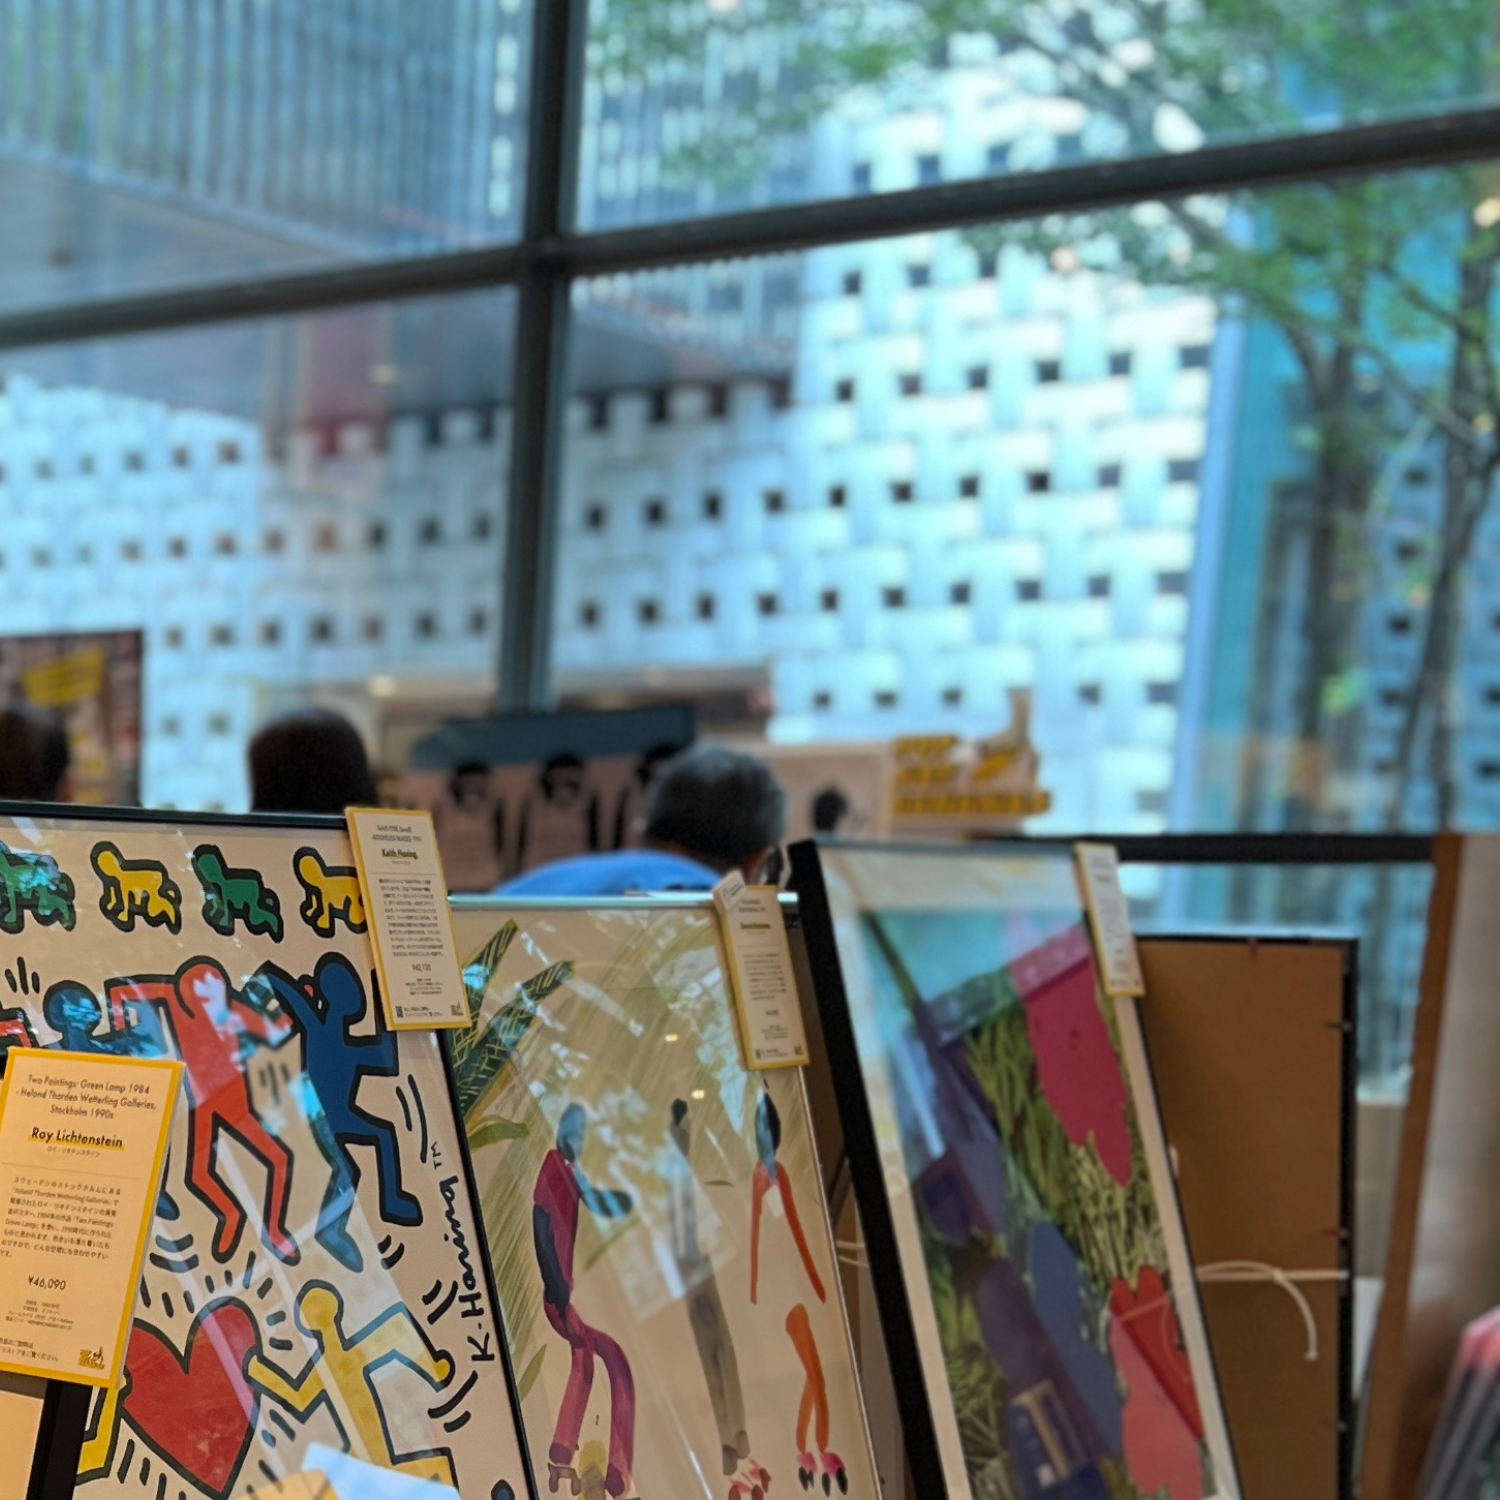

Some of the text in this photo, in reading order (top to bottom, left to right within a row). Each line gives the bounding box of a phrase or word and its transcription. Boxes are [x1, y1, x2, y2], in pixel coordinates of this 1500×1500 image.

[28, 1074, 43, 1085] Two
[80, 1079, 104, 1091] Green
[105, 1082, 126, 1094] Lamp
[128, 1083, 150, 1095] 1984
[50, 1104, 87, 1116] Stockholm
[31, 1127, 123, 1148] Roy Lichtenstein
[27, 1275, 67, 1291] ¥46,090
